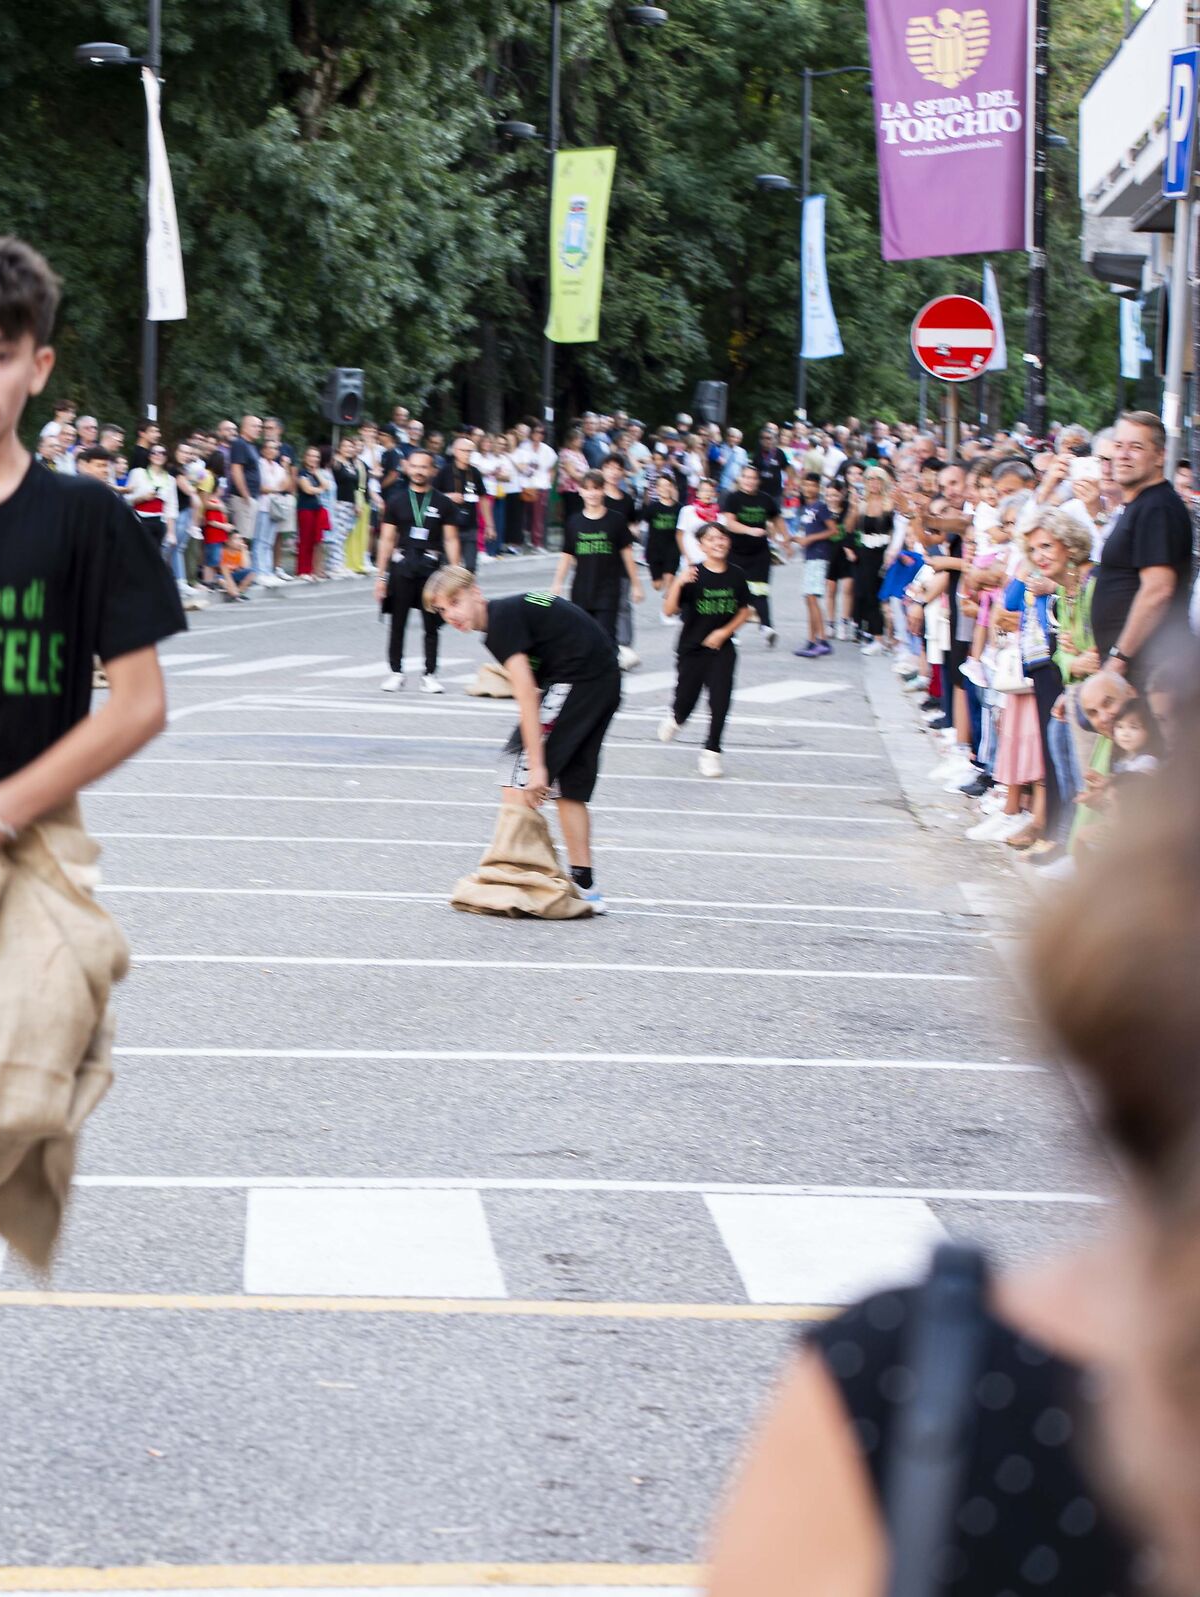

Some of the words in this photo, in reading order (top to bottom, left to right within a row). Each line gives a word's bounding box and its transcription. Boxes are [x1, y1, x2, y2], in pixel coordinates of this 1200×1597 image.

[880, 101, 912, 119] LA
[913, 96, 974, 118] SFIDA
[975, 89, 1020, 110] DEL
[1166, 62, 1192, 184] P
[880, 107, 1022, 144] TORCHIO
[22, 578, 46, 620] di
